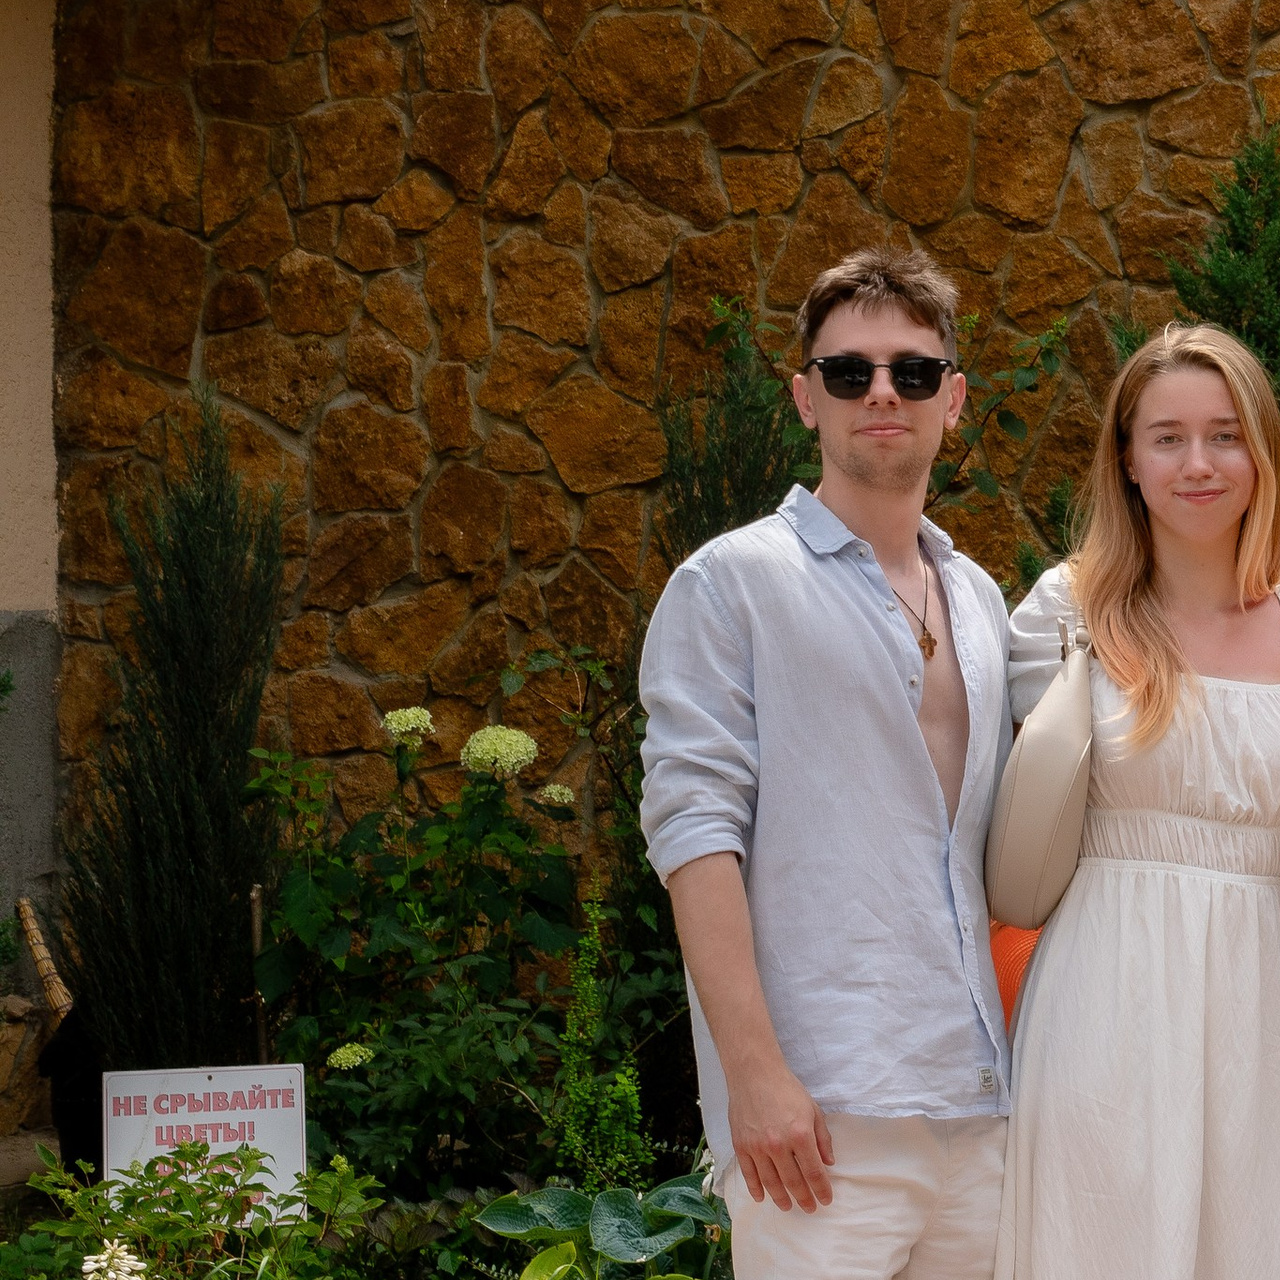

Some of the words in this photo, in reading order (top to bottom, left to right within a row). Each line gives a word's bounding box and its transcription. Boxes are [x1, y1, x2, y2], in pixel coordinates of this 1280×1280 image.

[112, 1096, 147, 1117] НЕ
[153, 1084, 295, 1114] СРЫВАЙТЕ
[155, 1121, 256, 1148] ЦВЕТЫ!
